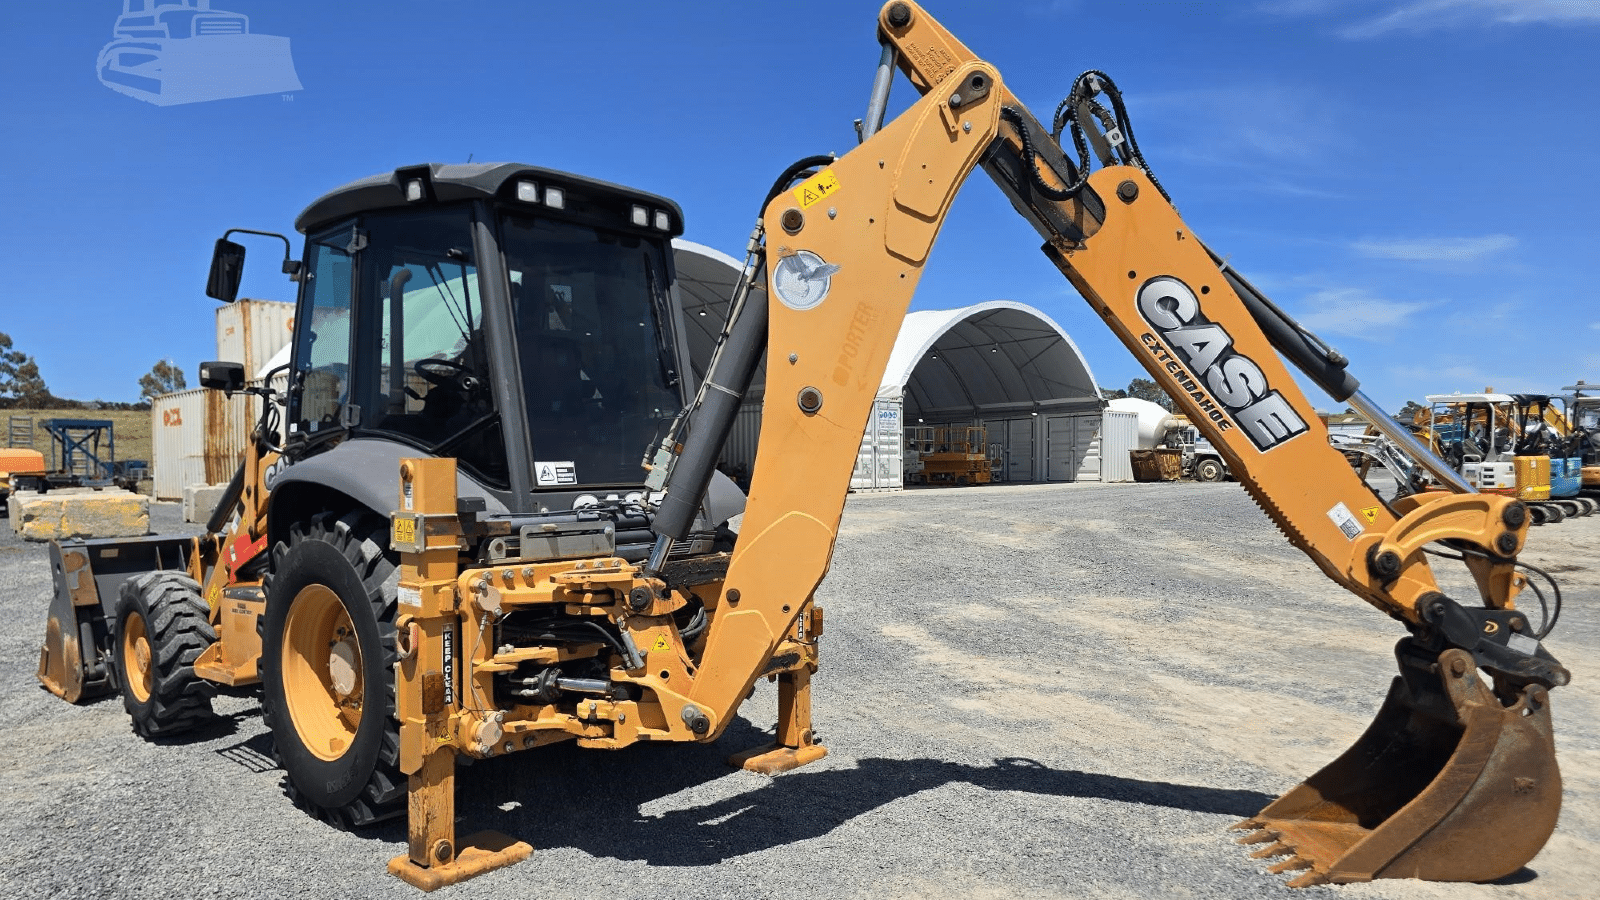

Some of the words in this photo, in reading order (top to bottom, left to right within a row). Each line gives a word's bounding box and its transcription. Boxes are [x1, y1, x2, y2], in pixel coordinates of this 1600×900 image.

[1138, 276, 1309, 451] CASE
[1140, 332, 1232, 432] EXTENDAHOE
[444, 632, 452, 663] KEEP
[444, 665, 452, 703] CLEAR
